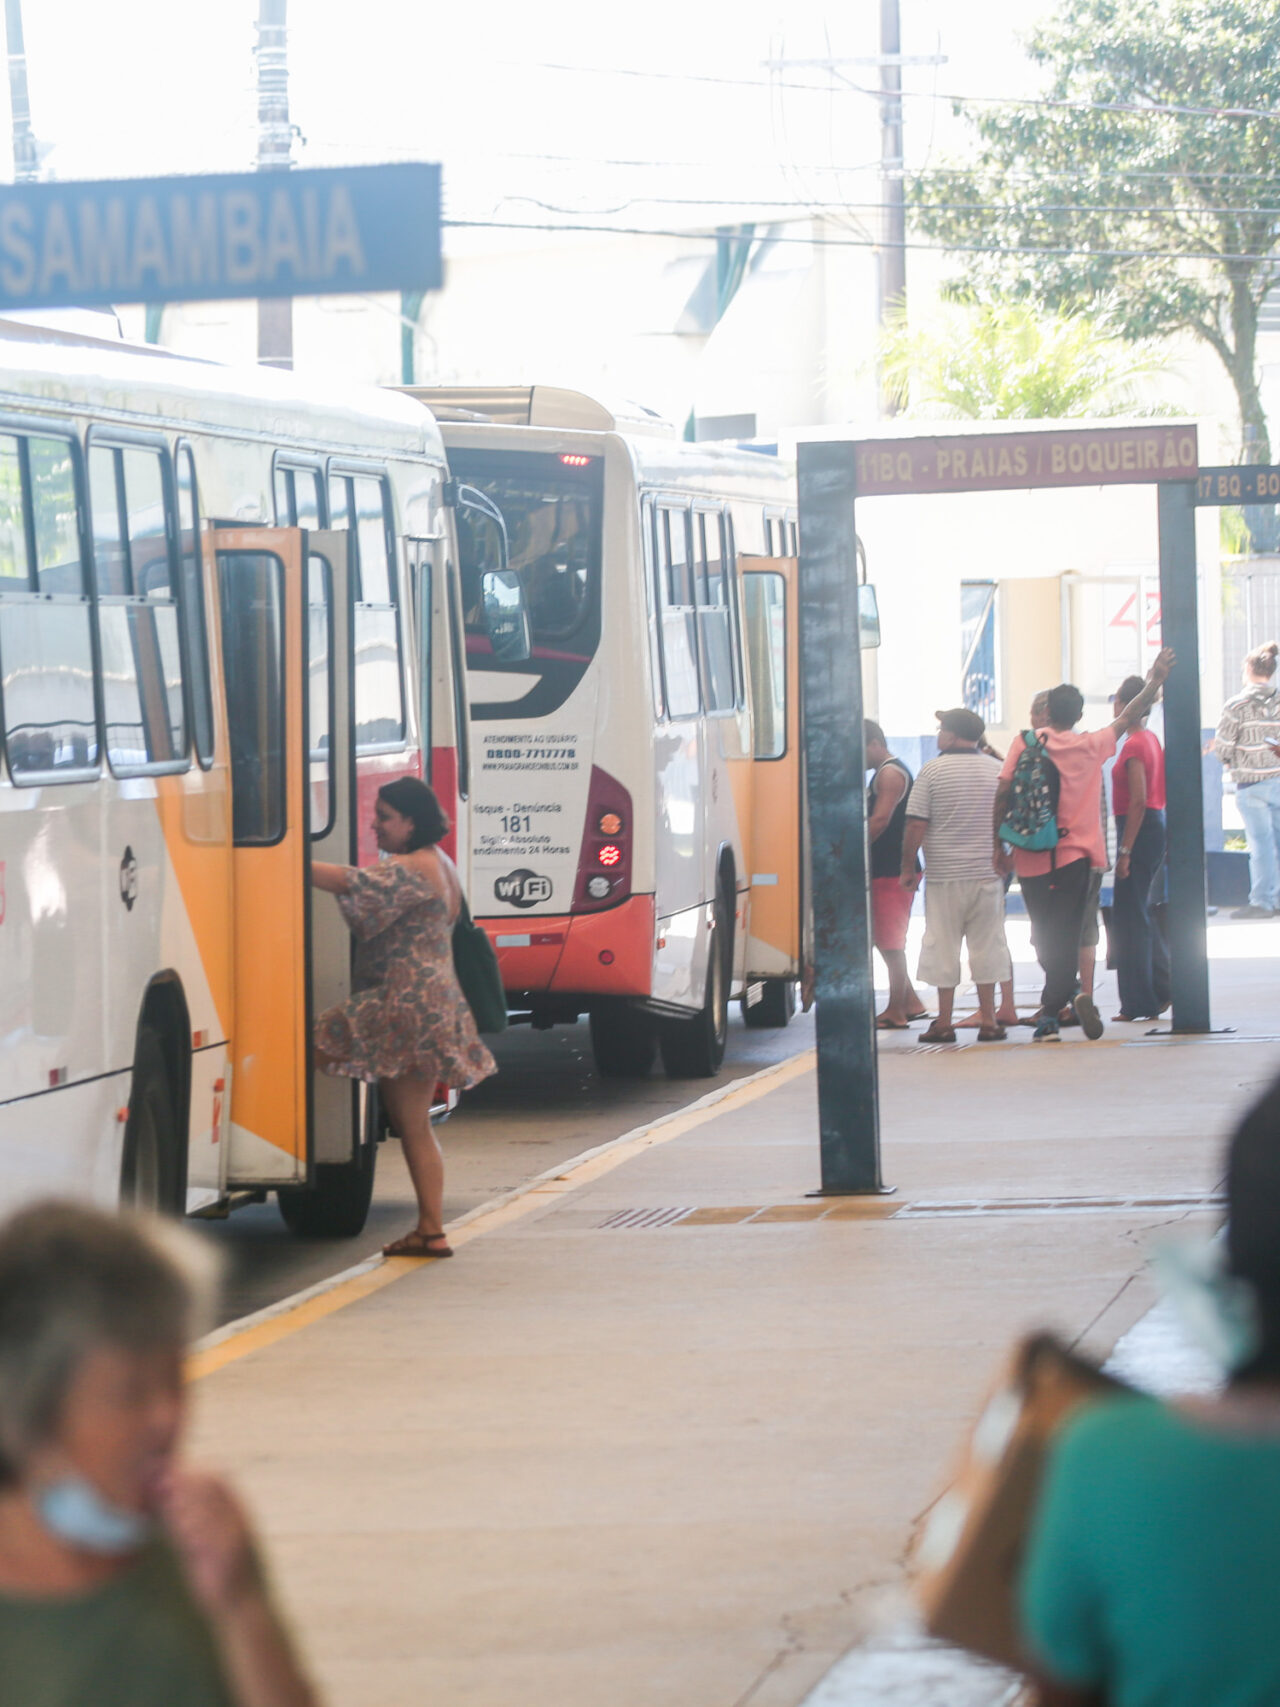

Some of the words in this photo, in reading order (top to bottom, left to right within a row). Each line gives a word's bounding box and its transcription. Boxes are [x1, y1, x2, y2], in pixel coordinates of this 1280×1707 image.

[936, 445, 1028, 480] PRAIAS
[1036, 445, 1044, 476] /
[1051, 432, 1195, 474] BOQUEIRÃO
[1218, 475, 1242, 497] BQ
[534, 735, 545, 744] AO
[487, 749, 576, 759] 0800-7717778
[513, 801, 562, 813] Denúncia
[500, 815, 531, 833] 181
[510, 835, 551, 844] Absoluto
[528, 846, 540, 855] 24
[542, 846, 570, 855] Horas
